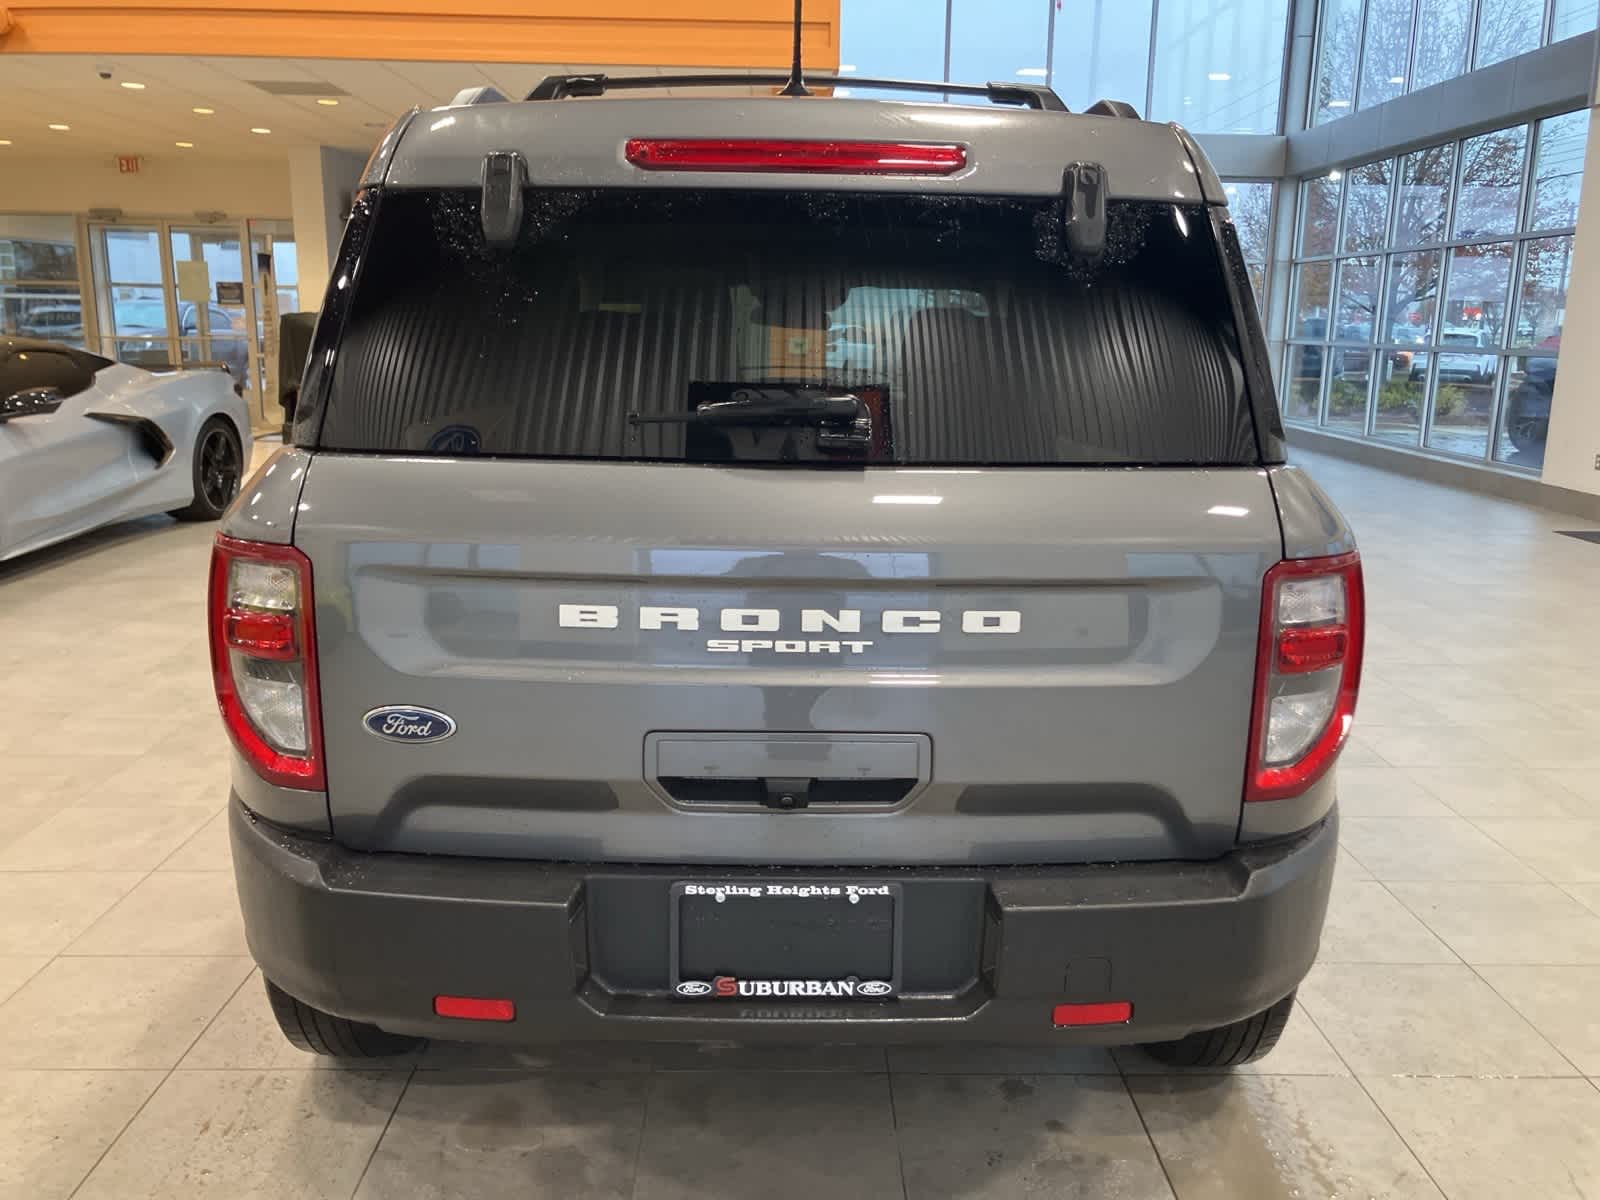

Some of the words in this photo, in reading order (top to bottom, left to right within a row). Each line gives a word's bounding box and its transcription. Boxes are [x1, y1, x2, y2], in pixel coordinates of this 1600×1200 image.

[558, 604, 1022, 634] BRONCO
[706, 639, 874, 654] SPORT
[382, 712, 433, 736] Ford
[684, 884, 763, 898] Sterling
[766, 884, 841, 898] Heights
[844, 884, 890, 896] Ford
[715, 977, 855, 997] SUBURBAN
